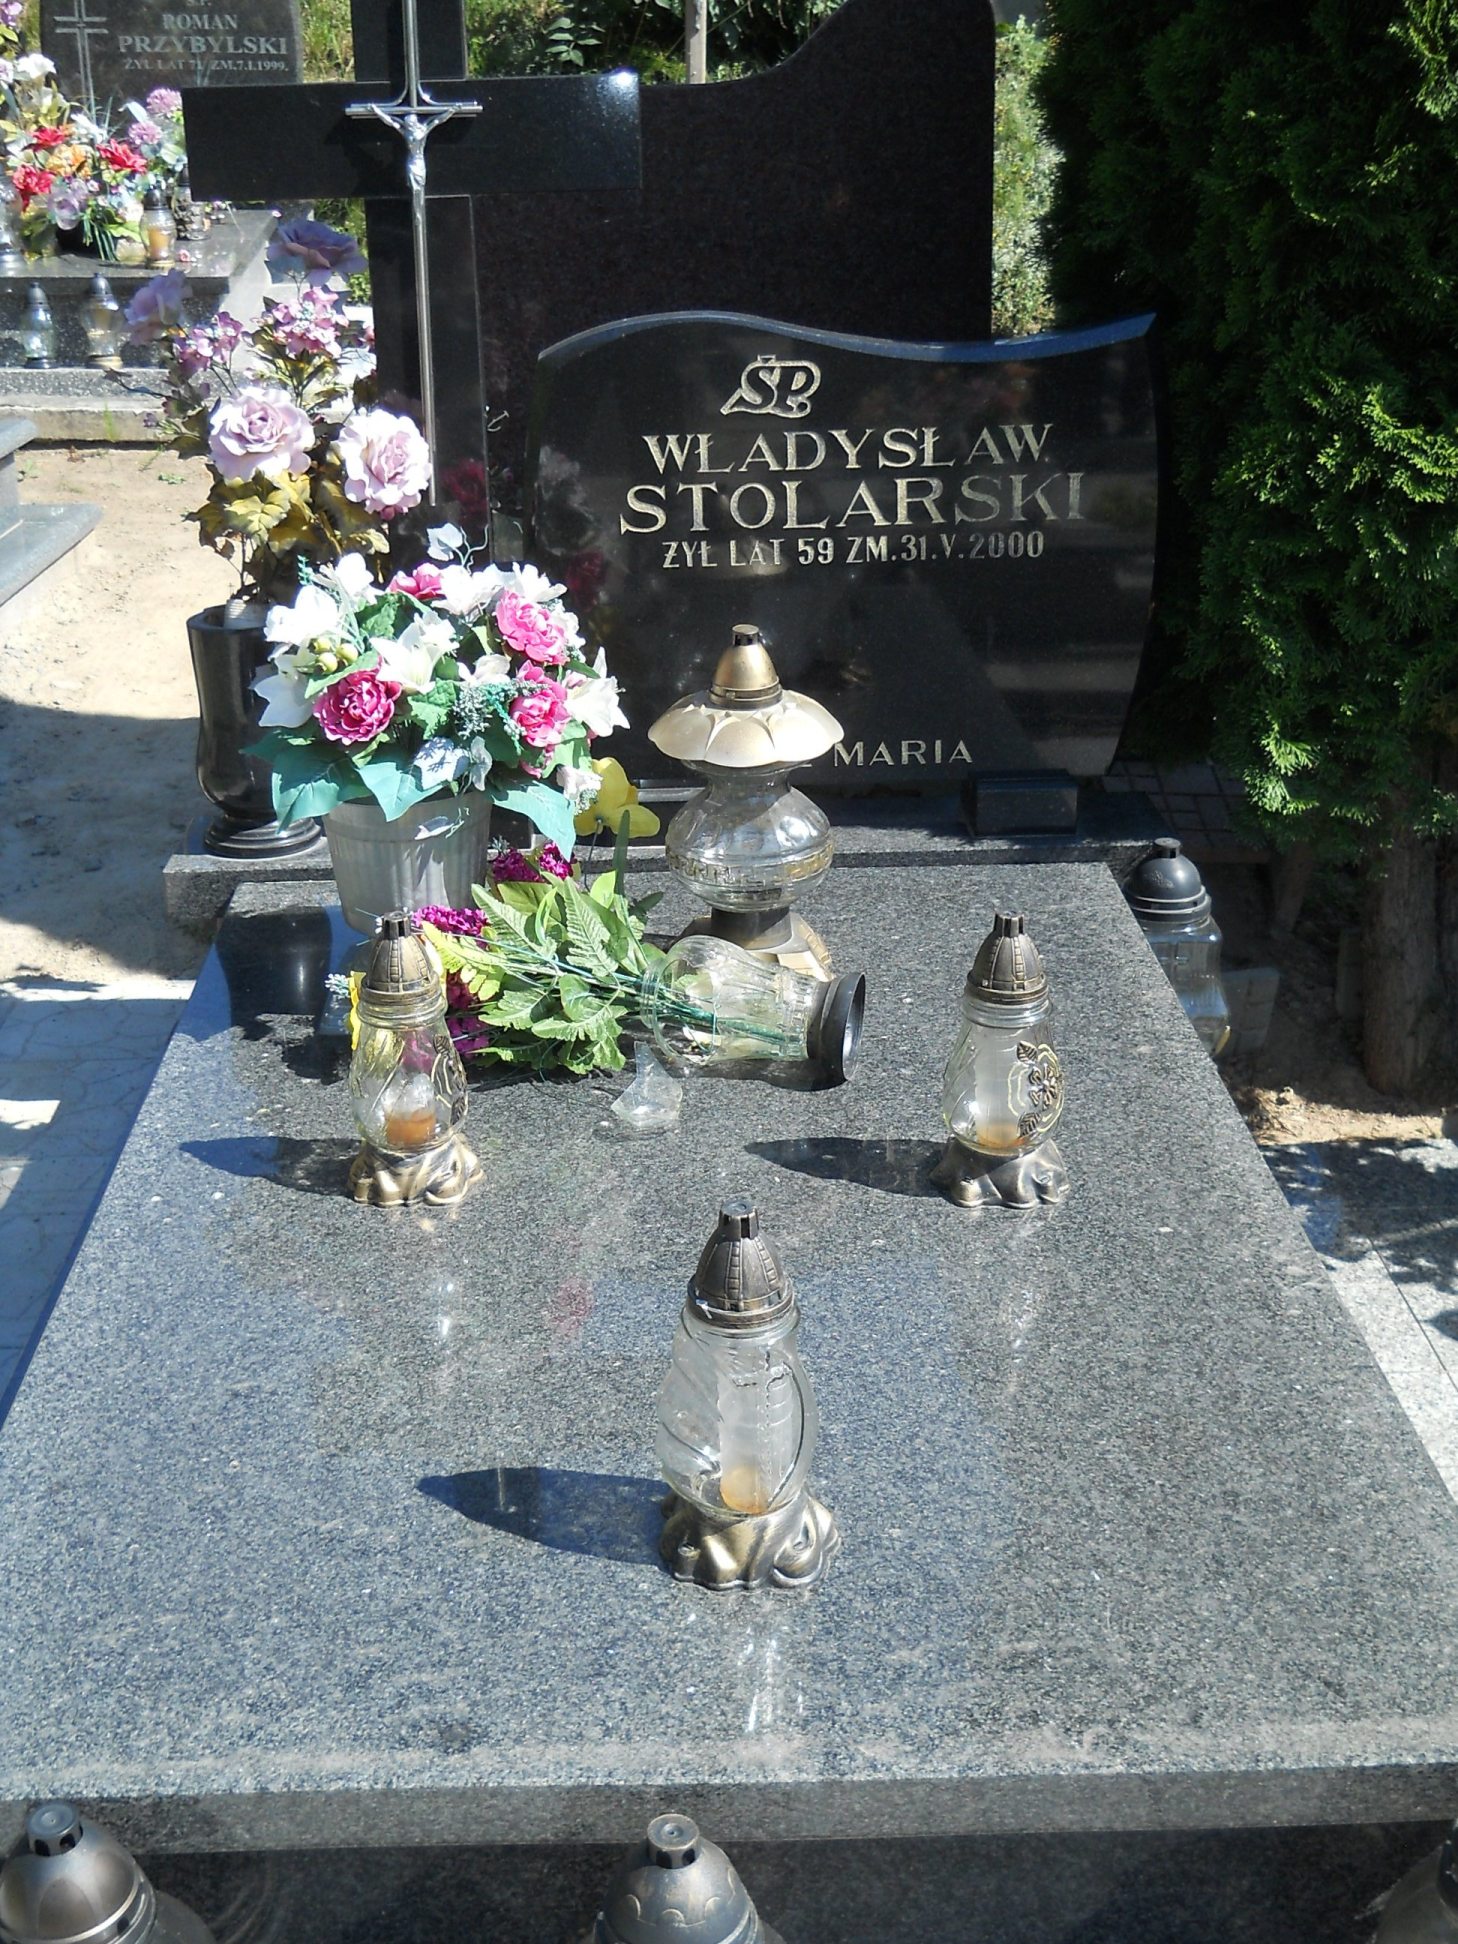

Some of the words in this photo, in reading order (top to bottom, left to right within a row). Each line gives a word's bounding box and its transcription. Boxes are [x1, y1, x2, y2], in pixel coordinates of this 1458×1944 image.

[162, 13, 238, 30] ROMAN
[119, 36, 288, 55] PRZYBYLSKI
[641, 423, 1054, 475] WŁADYSŁAW
[619, 472, 1085, 535] STOLARSKI
[729, 539, 785, 566] LAT
[797, 537, 834, 565] 59
[834, 739, 973, 767] MARIA
